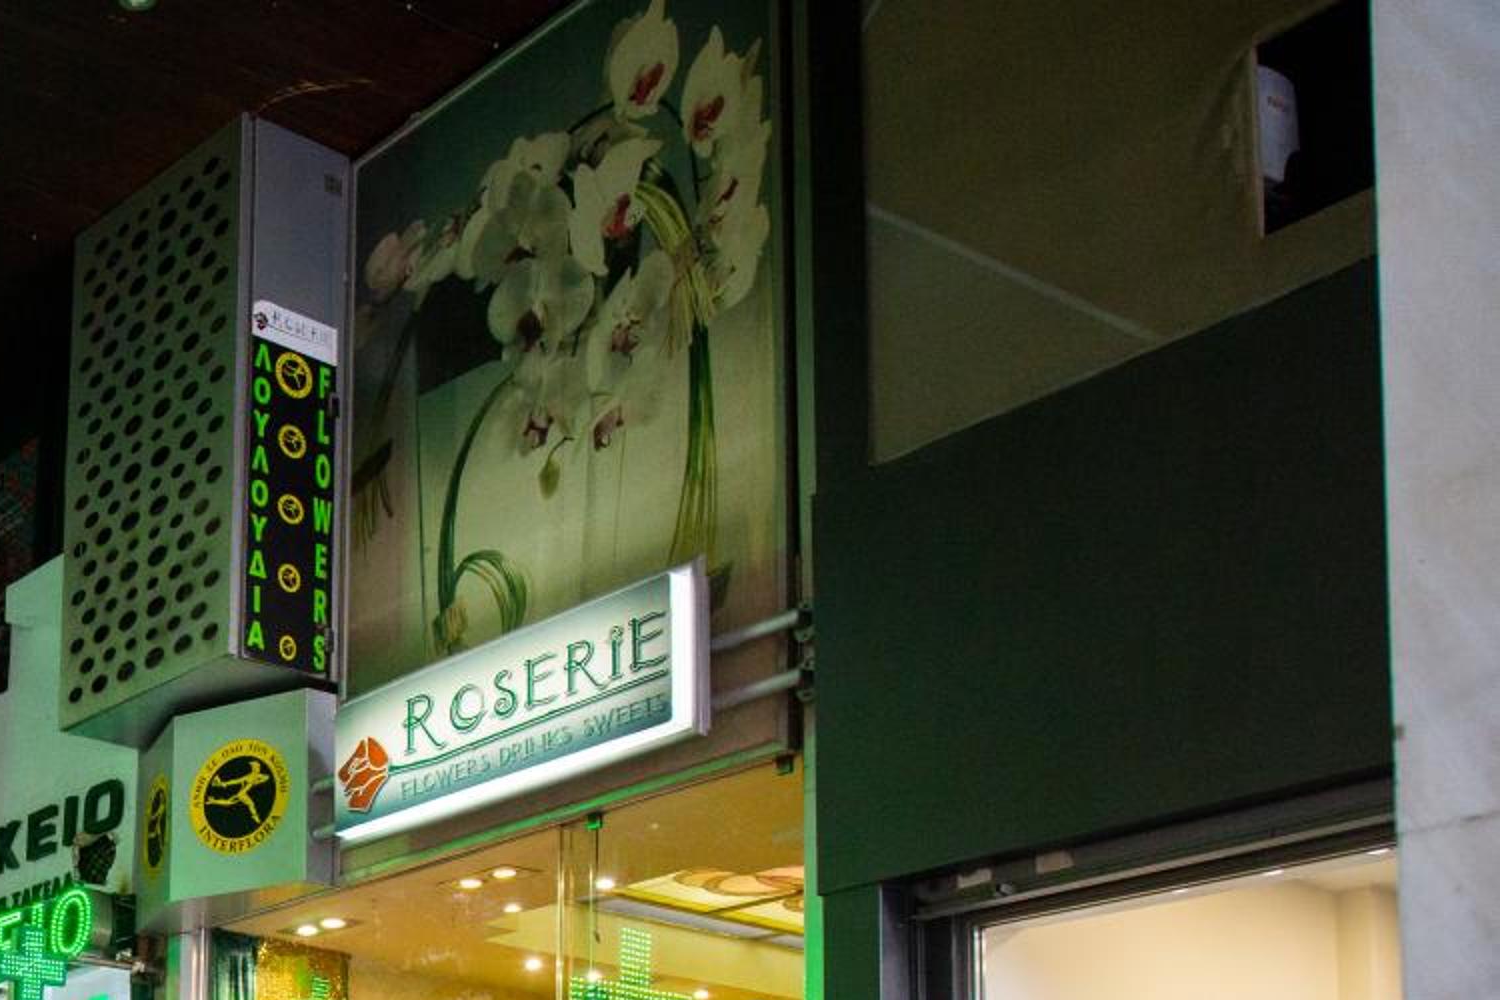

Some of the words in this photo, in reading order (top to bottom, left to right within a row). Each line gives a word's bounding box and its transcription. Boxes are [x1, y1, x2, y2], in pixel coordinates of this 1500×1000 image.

[247, 343, 272, 650] ΛΟΥΛΟΥΔΙΑ
[312, 365, 332, 674] FLOWERS
[401, 753, 492, 801] FLOWERS
[500, 725, 574, 766] DRINKS
